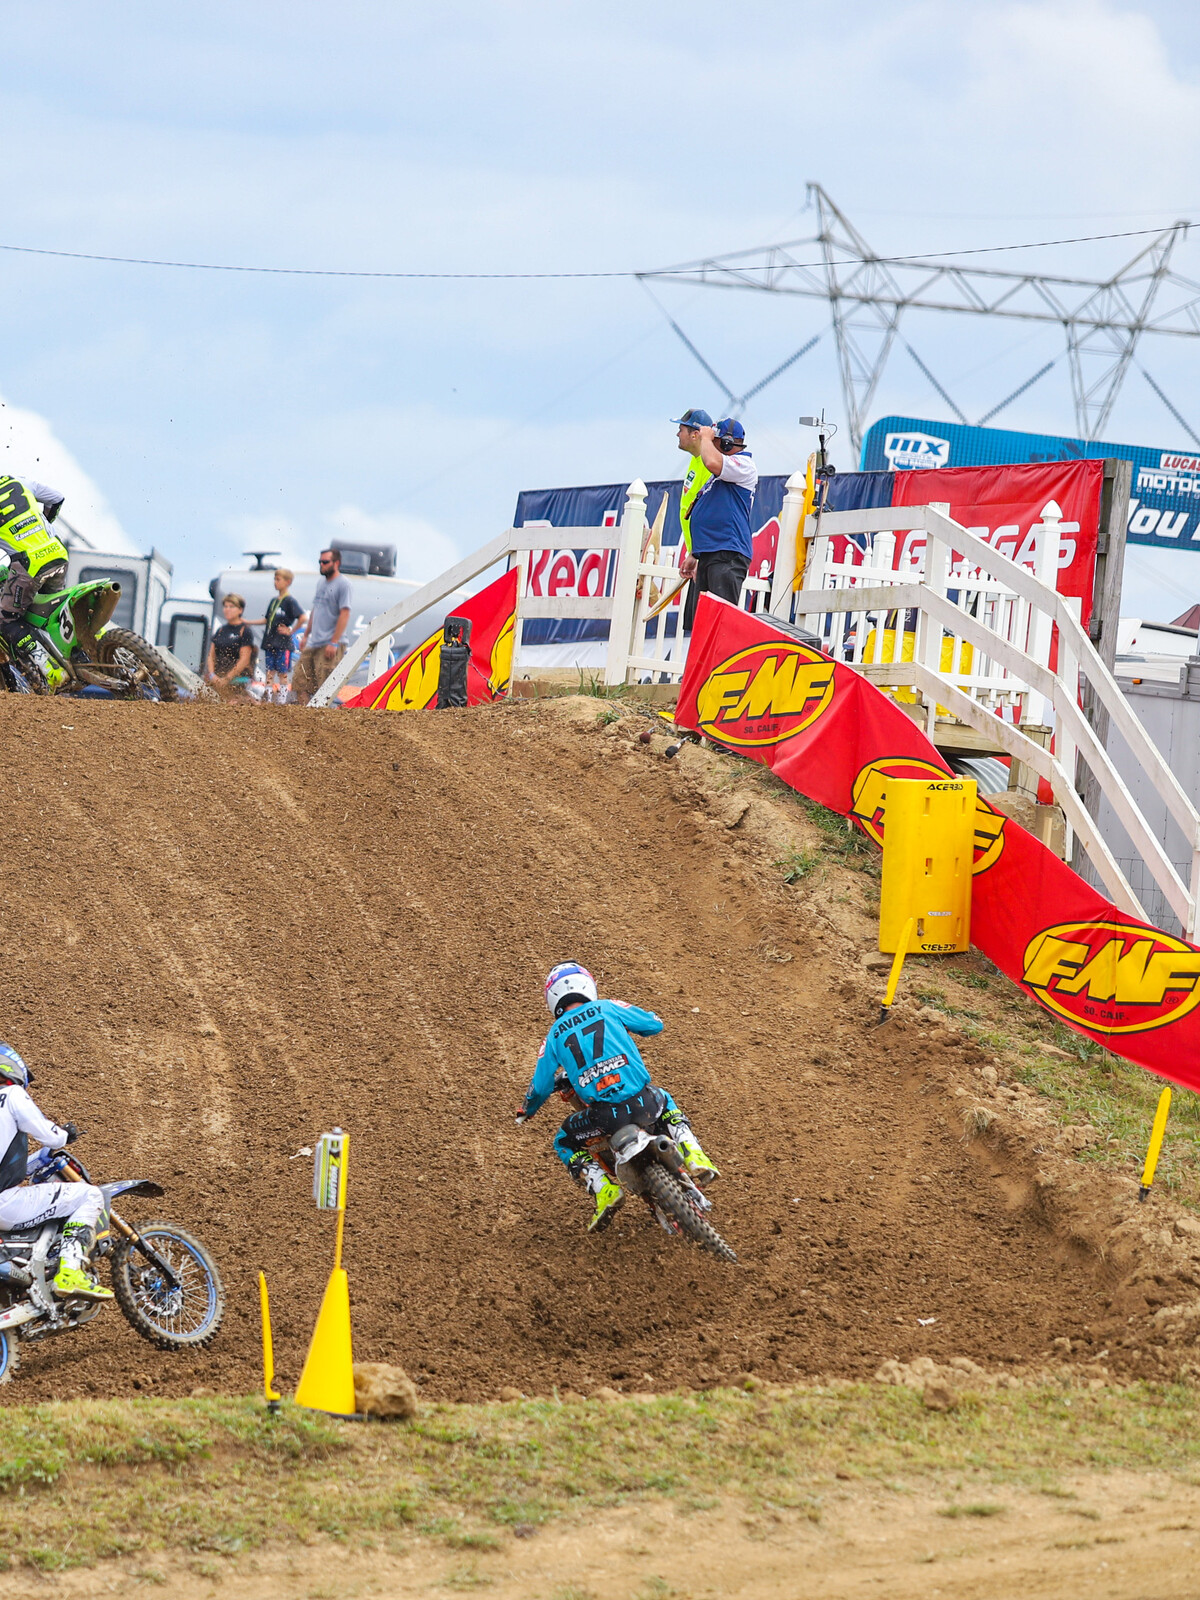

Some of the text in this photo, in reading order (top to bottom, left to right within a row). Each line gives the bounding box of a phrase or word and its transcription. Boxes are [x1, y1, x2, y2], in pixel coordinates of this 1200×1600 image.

[34, 543, 61, 560] ASTARS
[697, 652, 836, 727] FMF
[1020, 934, 1200, 1006] FMF
[564, 1019, 605, 1070] 17
